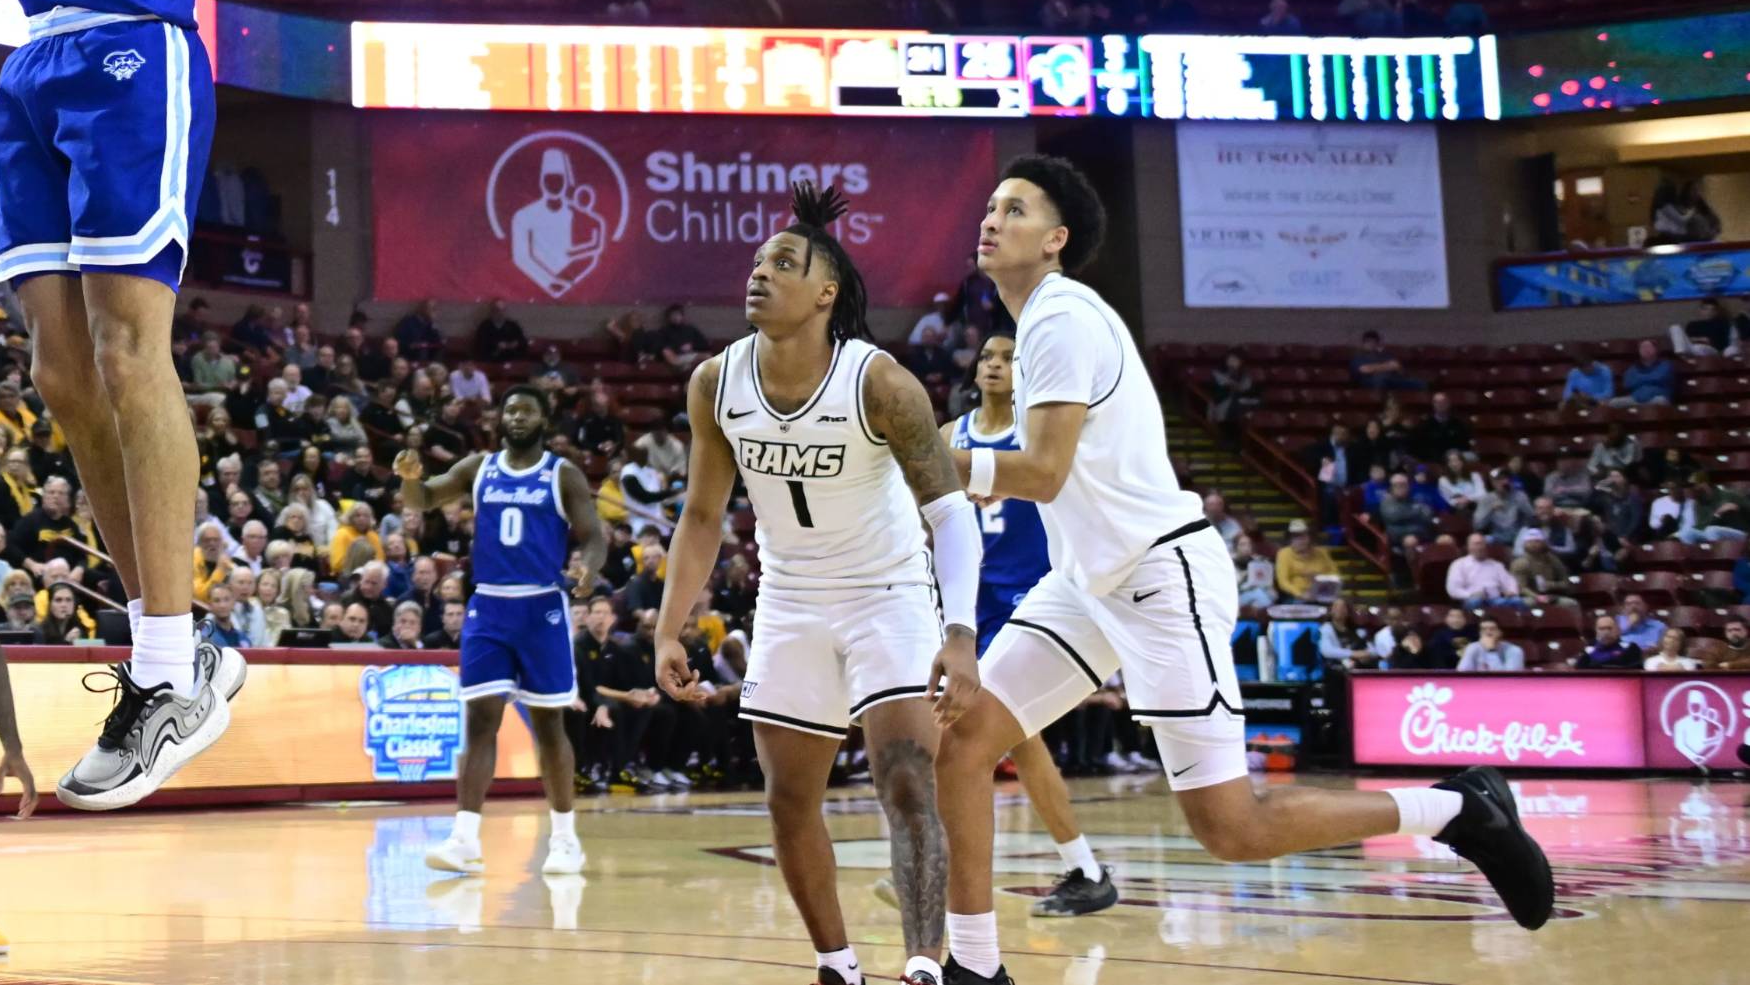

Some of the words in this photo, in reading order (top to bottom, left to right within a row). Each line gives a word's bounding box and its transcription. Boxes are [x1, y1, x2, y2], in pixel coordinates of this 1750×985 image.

[645, 150, 870, 194] Shriners
[645, 199, 872, 244] Childrs
[738, 437, 846, 478] RAMS
[786, 480, 814, 528] 1
[499, 506, 523, 547] 0
[1400, 700, 1586, 762] Chick-fil-A
